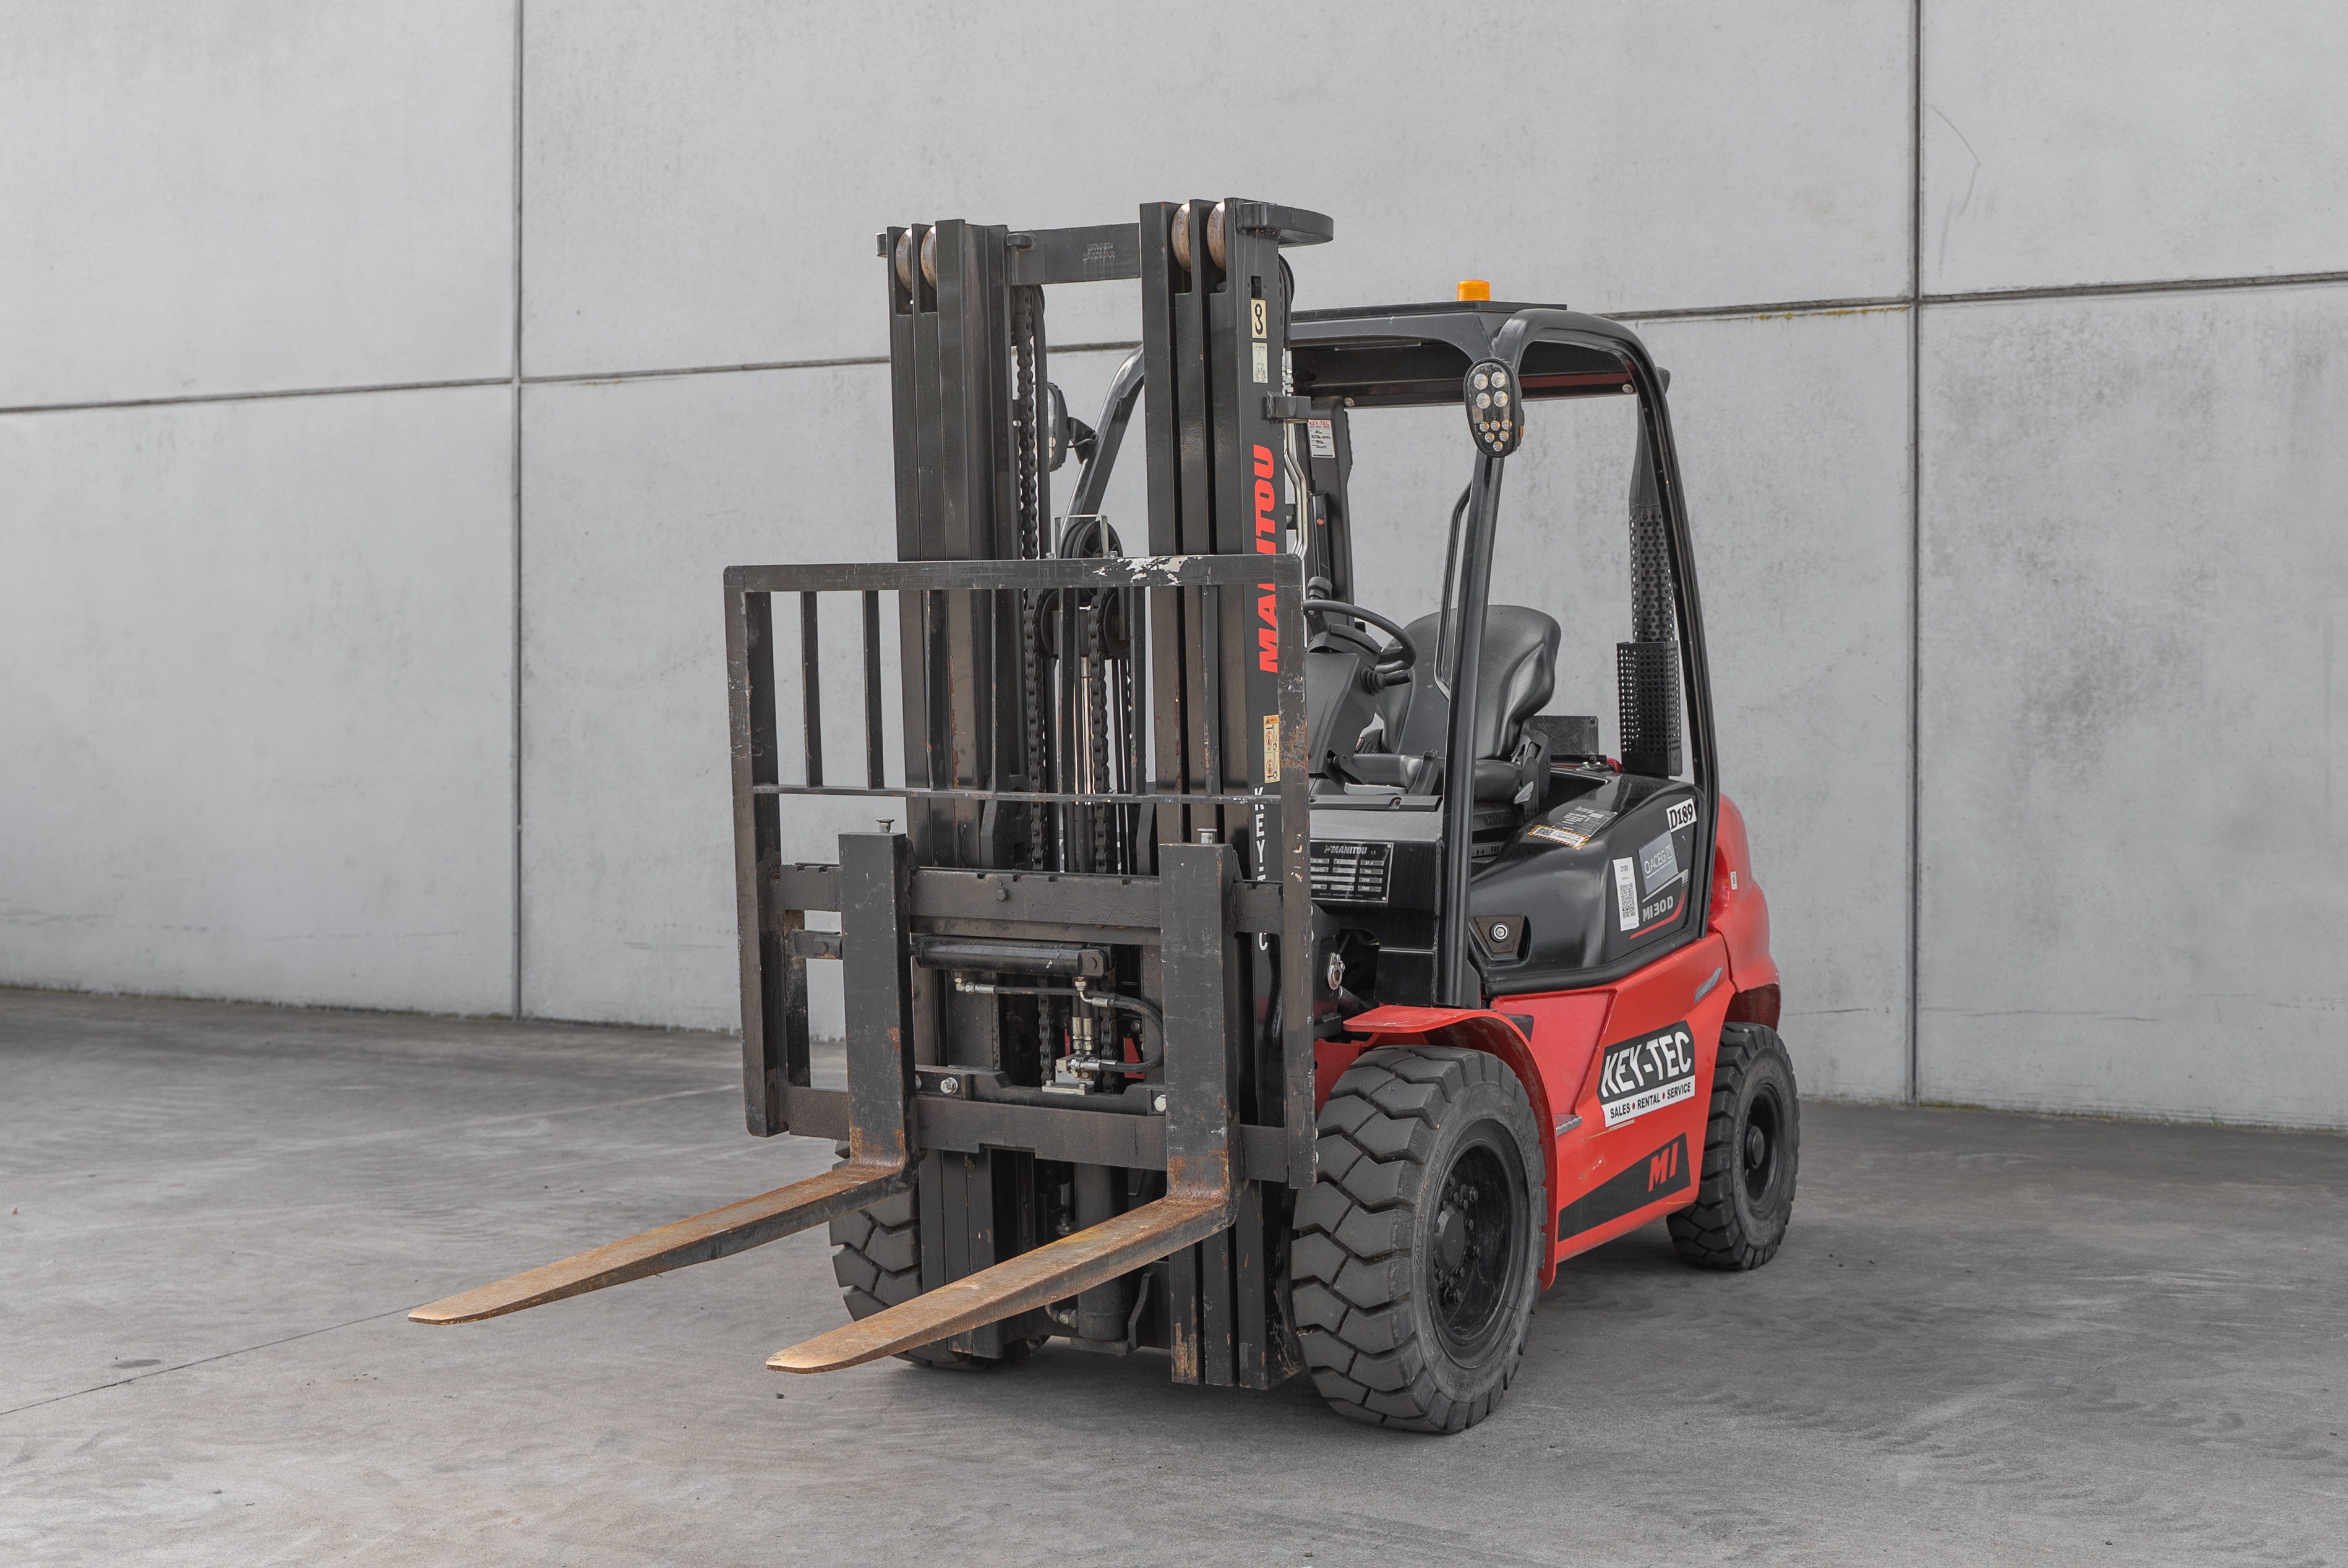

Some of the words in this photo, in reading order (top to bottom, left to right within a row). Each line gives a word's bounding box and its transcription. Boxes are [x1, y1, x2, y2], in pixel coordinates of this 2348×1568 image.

[1669, 803, 1694, 829] D189
[1330, 846, 1368, 855] MANITOU
[1600, 1031, 1692, 1098] KEY-TEC
[1609, 1103, 1630, 1120] SALES
[1637, 1094, 1661, 1110] RENTAL
[1666, 1082, 1692, 1099] SERVICE
[1648, 1141, 1679, 1193] MI
